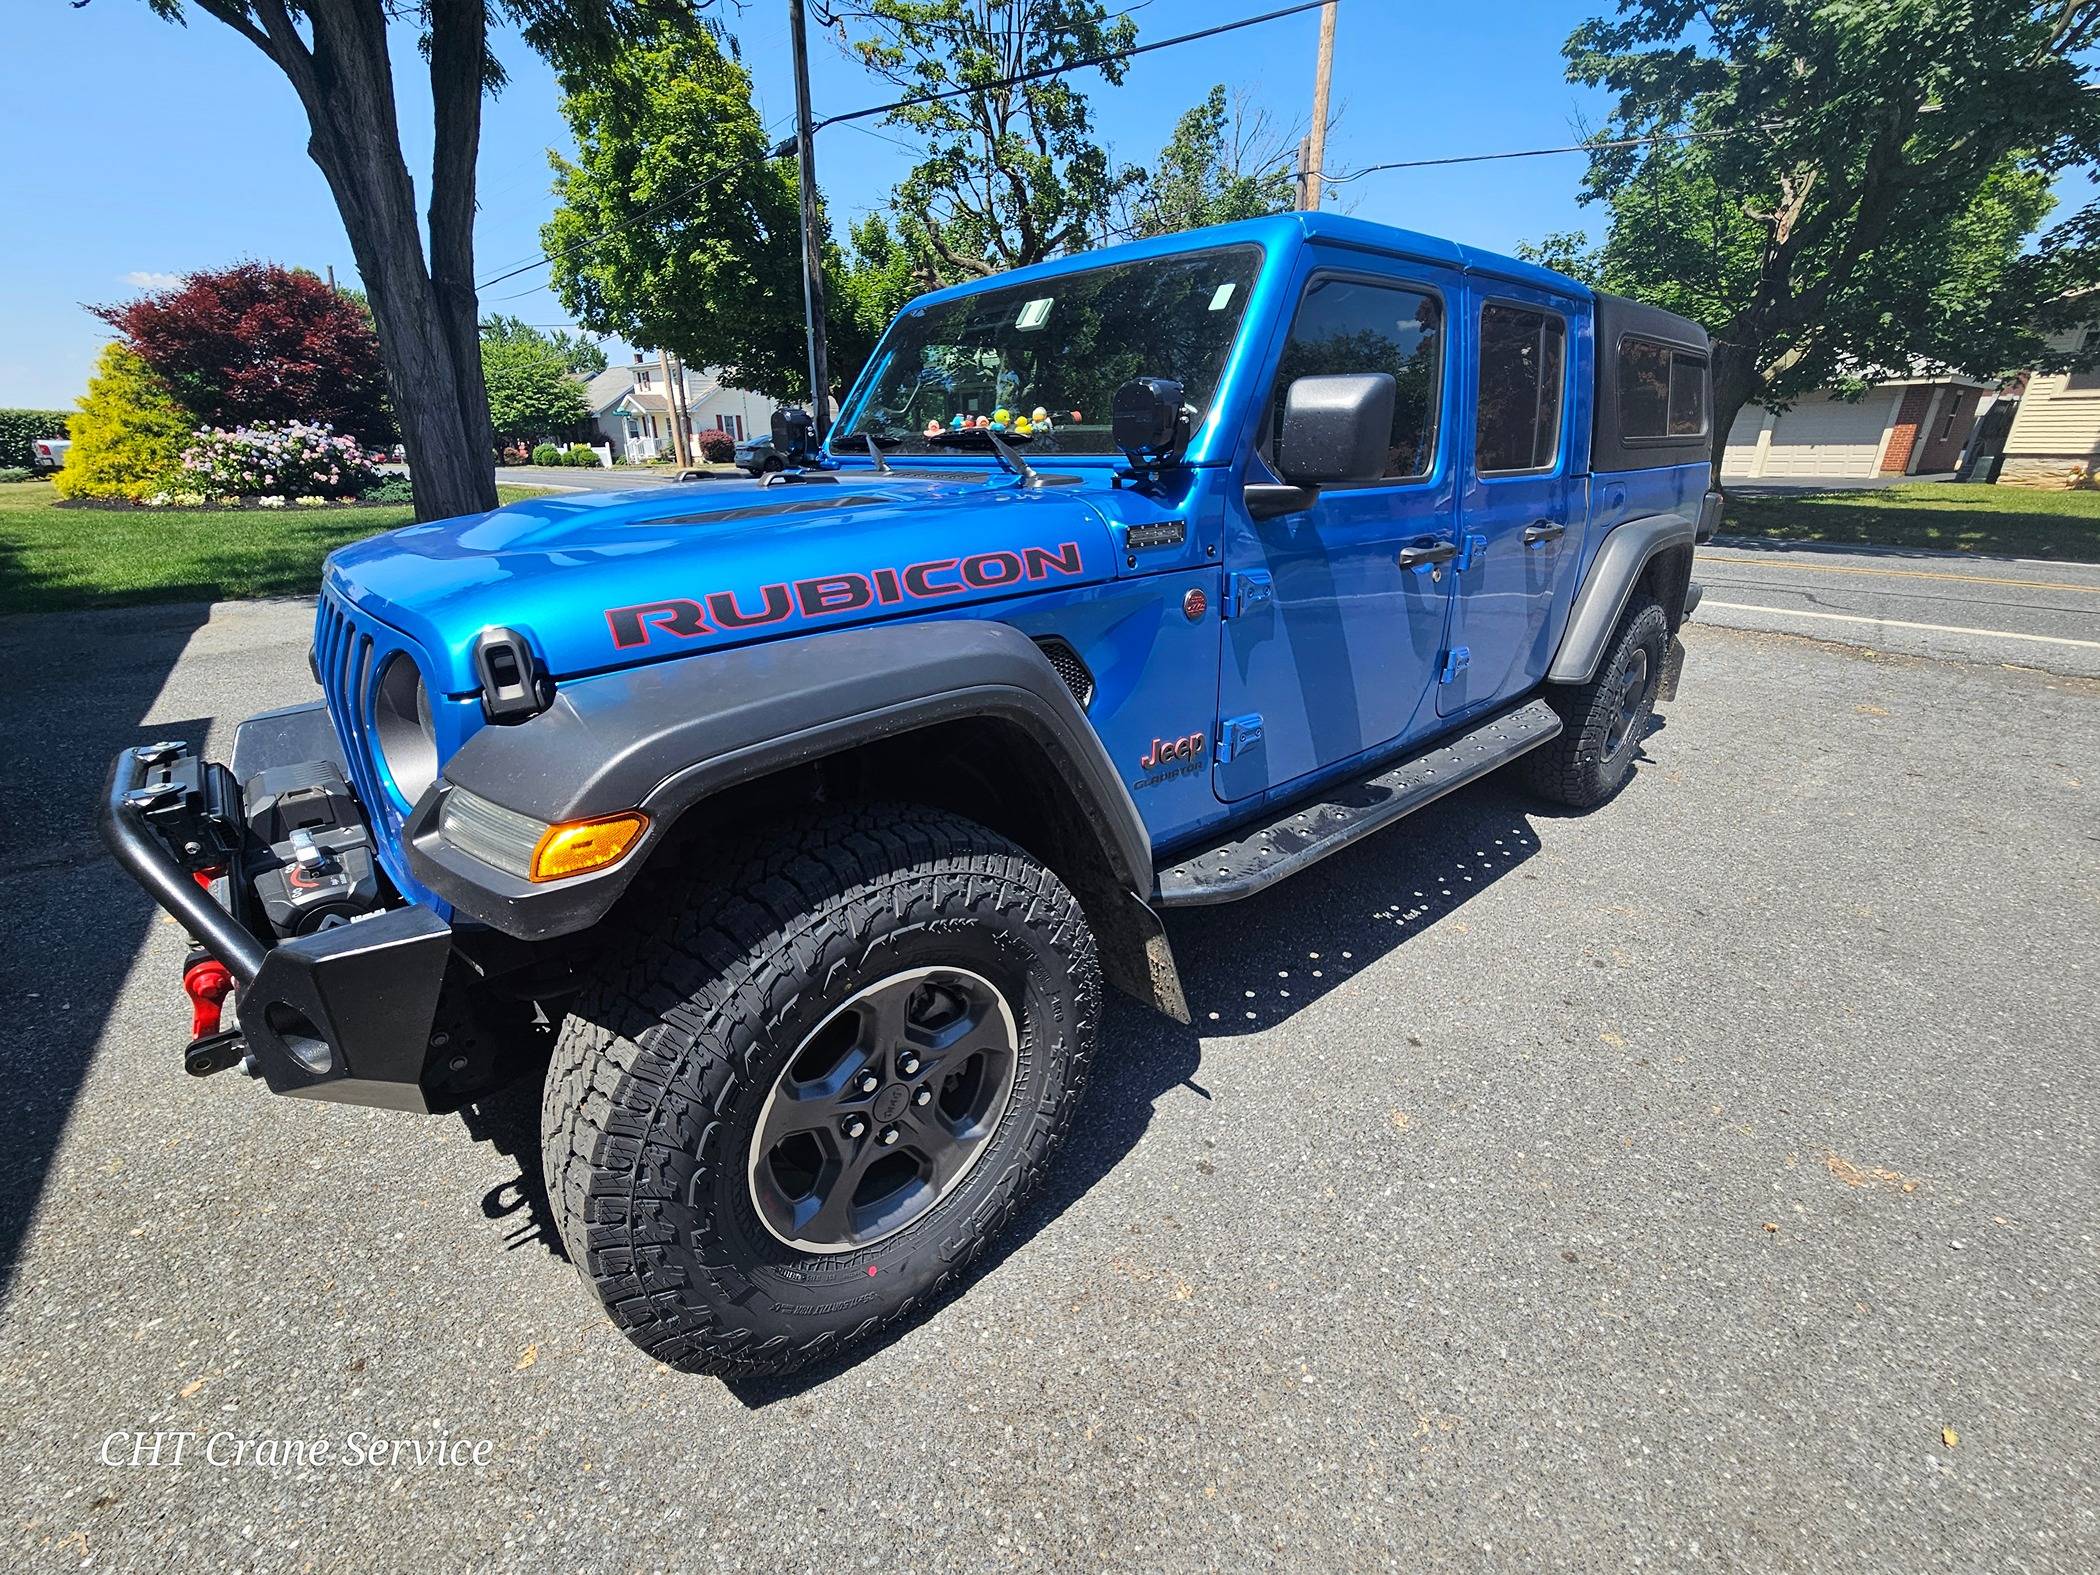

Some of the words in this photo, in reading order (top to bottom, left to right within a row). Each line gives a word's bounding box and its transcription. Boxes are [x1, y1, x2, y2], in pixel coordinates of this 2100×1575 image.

[604, 541, 1083, 650] RUBICON
[1141, 733, 1204, 768] Jeep
[1133, 761, 1203, 790] GLADIATOR
